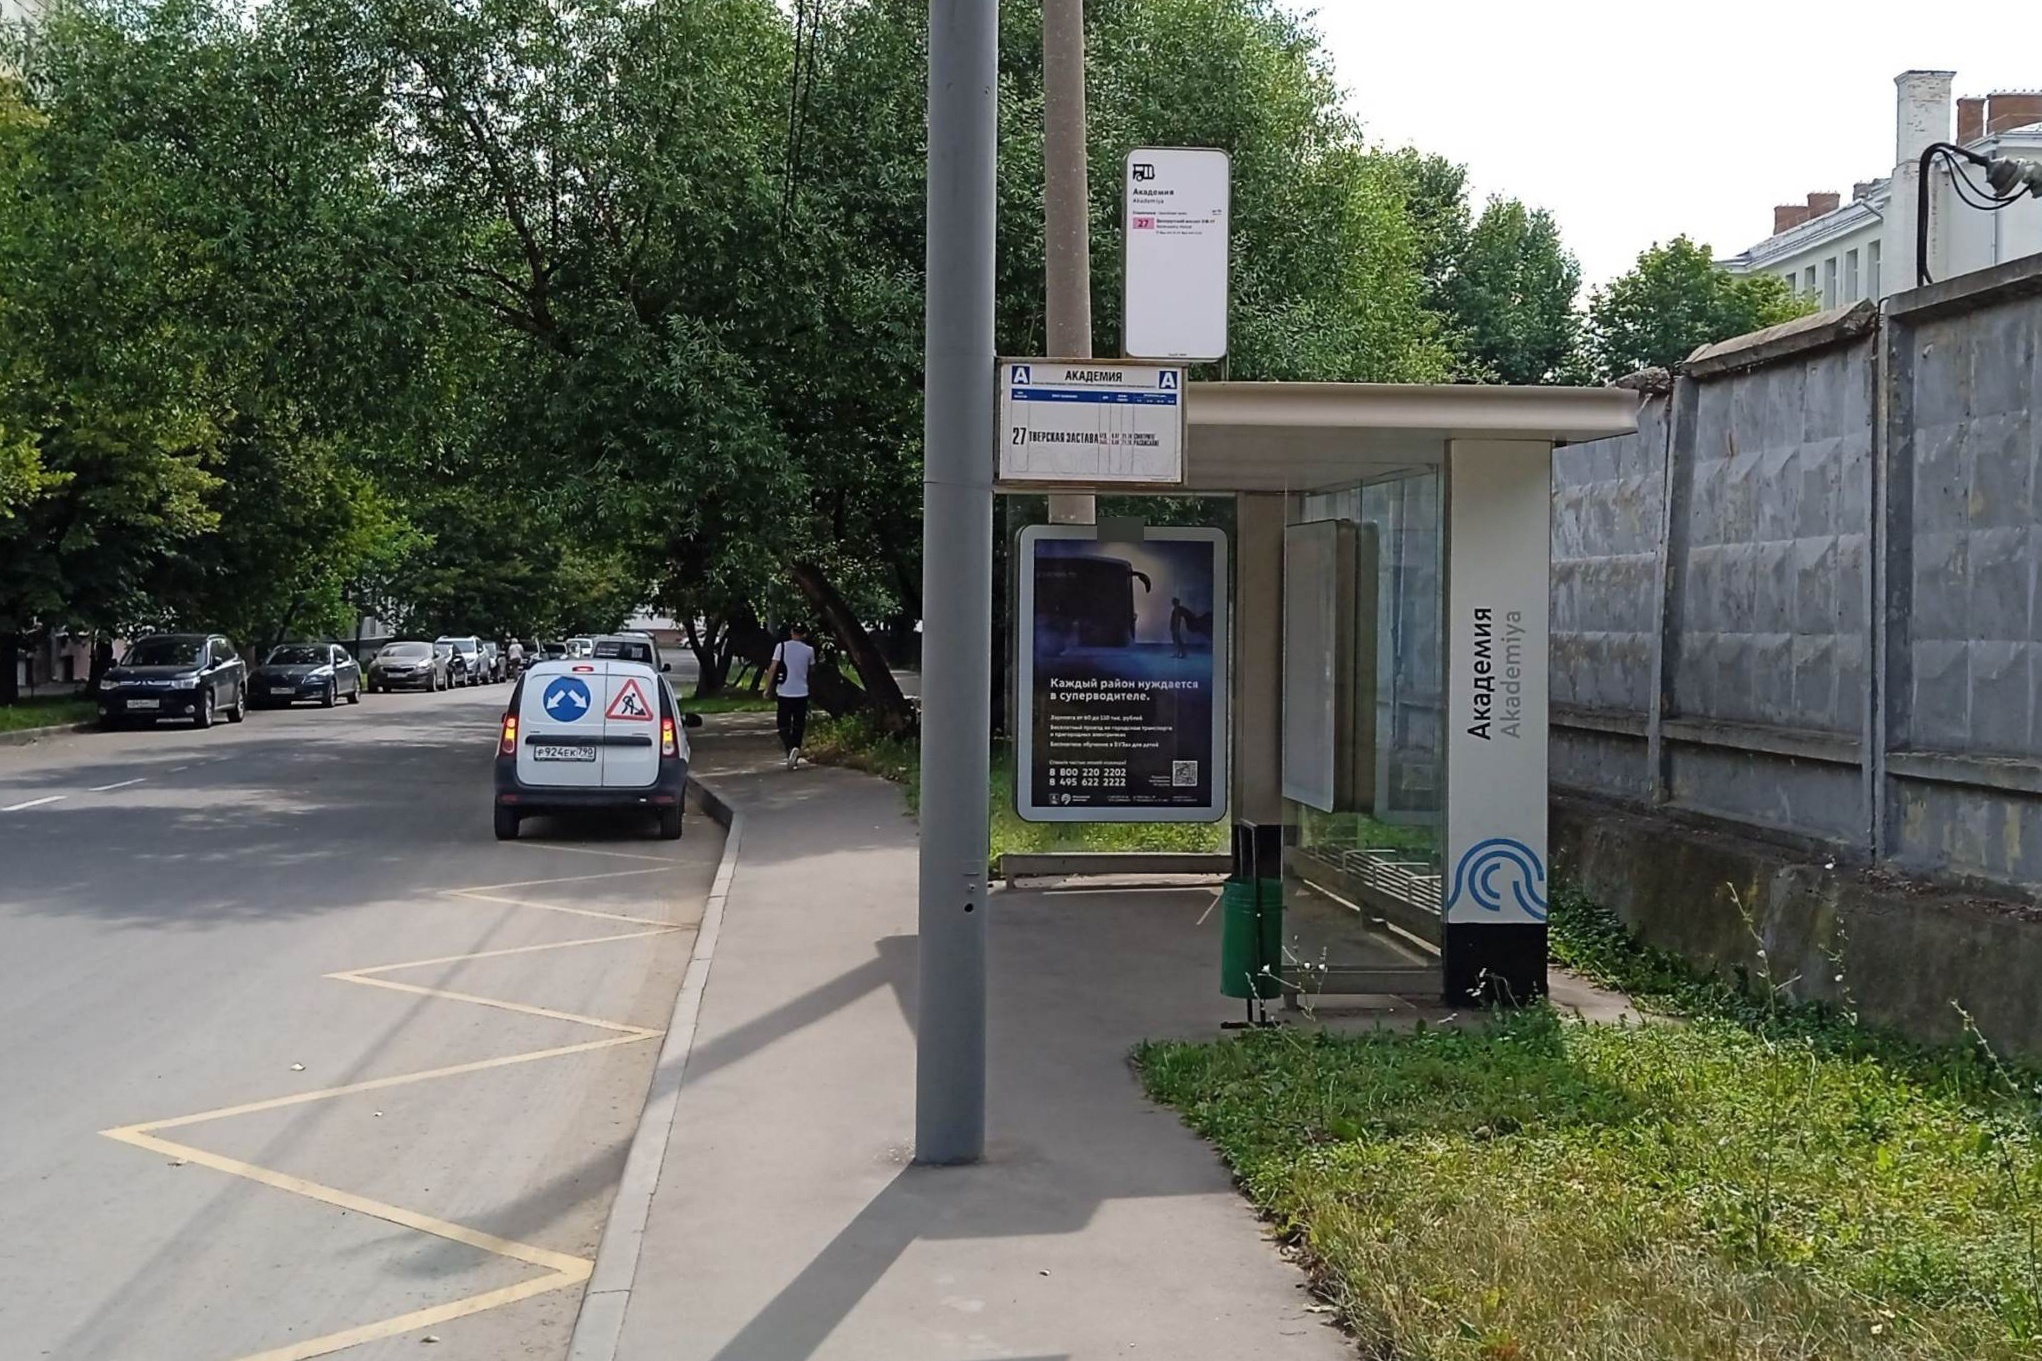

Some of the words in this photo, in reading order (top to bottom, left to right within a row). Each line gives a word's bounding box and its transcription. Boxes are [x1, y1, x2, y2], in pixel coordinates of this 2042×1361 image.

[1133, 188, 1174, 196] Академия
[1137, 220, 1149, 228] 27
[1065, 370, 1123, 383] АКАДЕМИЯ
[1012, 427, 1027, 445] 27
[1029, 431, 1065, 443] ТВЕРСКАЯ
[1066, 432, 1099, 444] ЗАСТАВА
[1467, 608, 1495, 740] Академия
[1500, 611, 1526, 739] Akademiya
[1050, 678, 1098, 689] Каждый
[1100, 678, 1135, 690] район
[1138, 681, 1199, 690] нуждается
[1060, 692, 1150, 702] суперводителе.
[1049, 768, 1056, 776] 8
[1060, 768, 1078, 776] 800
[1082, 768, 1100, 777] 220
[1103, 768, 1127, 777] 2202
[1049, 778, 1056, 786] 8
[1059, 778, 1078, 786] 495
[1081, 778, 1099, 786] 622
[1103, 778, 1126, 786] 2222
